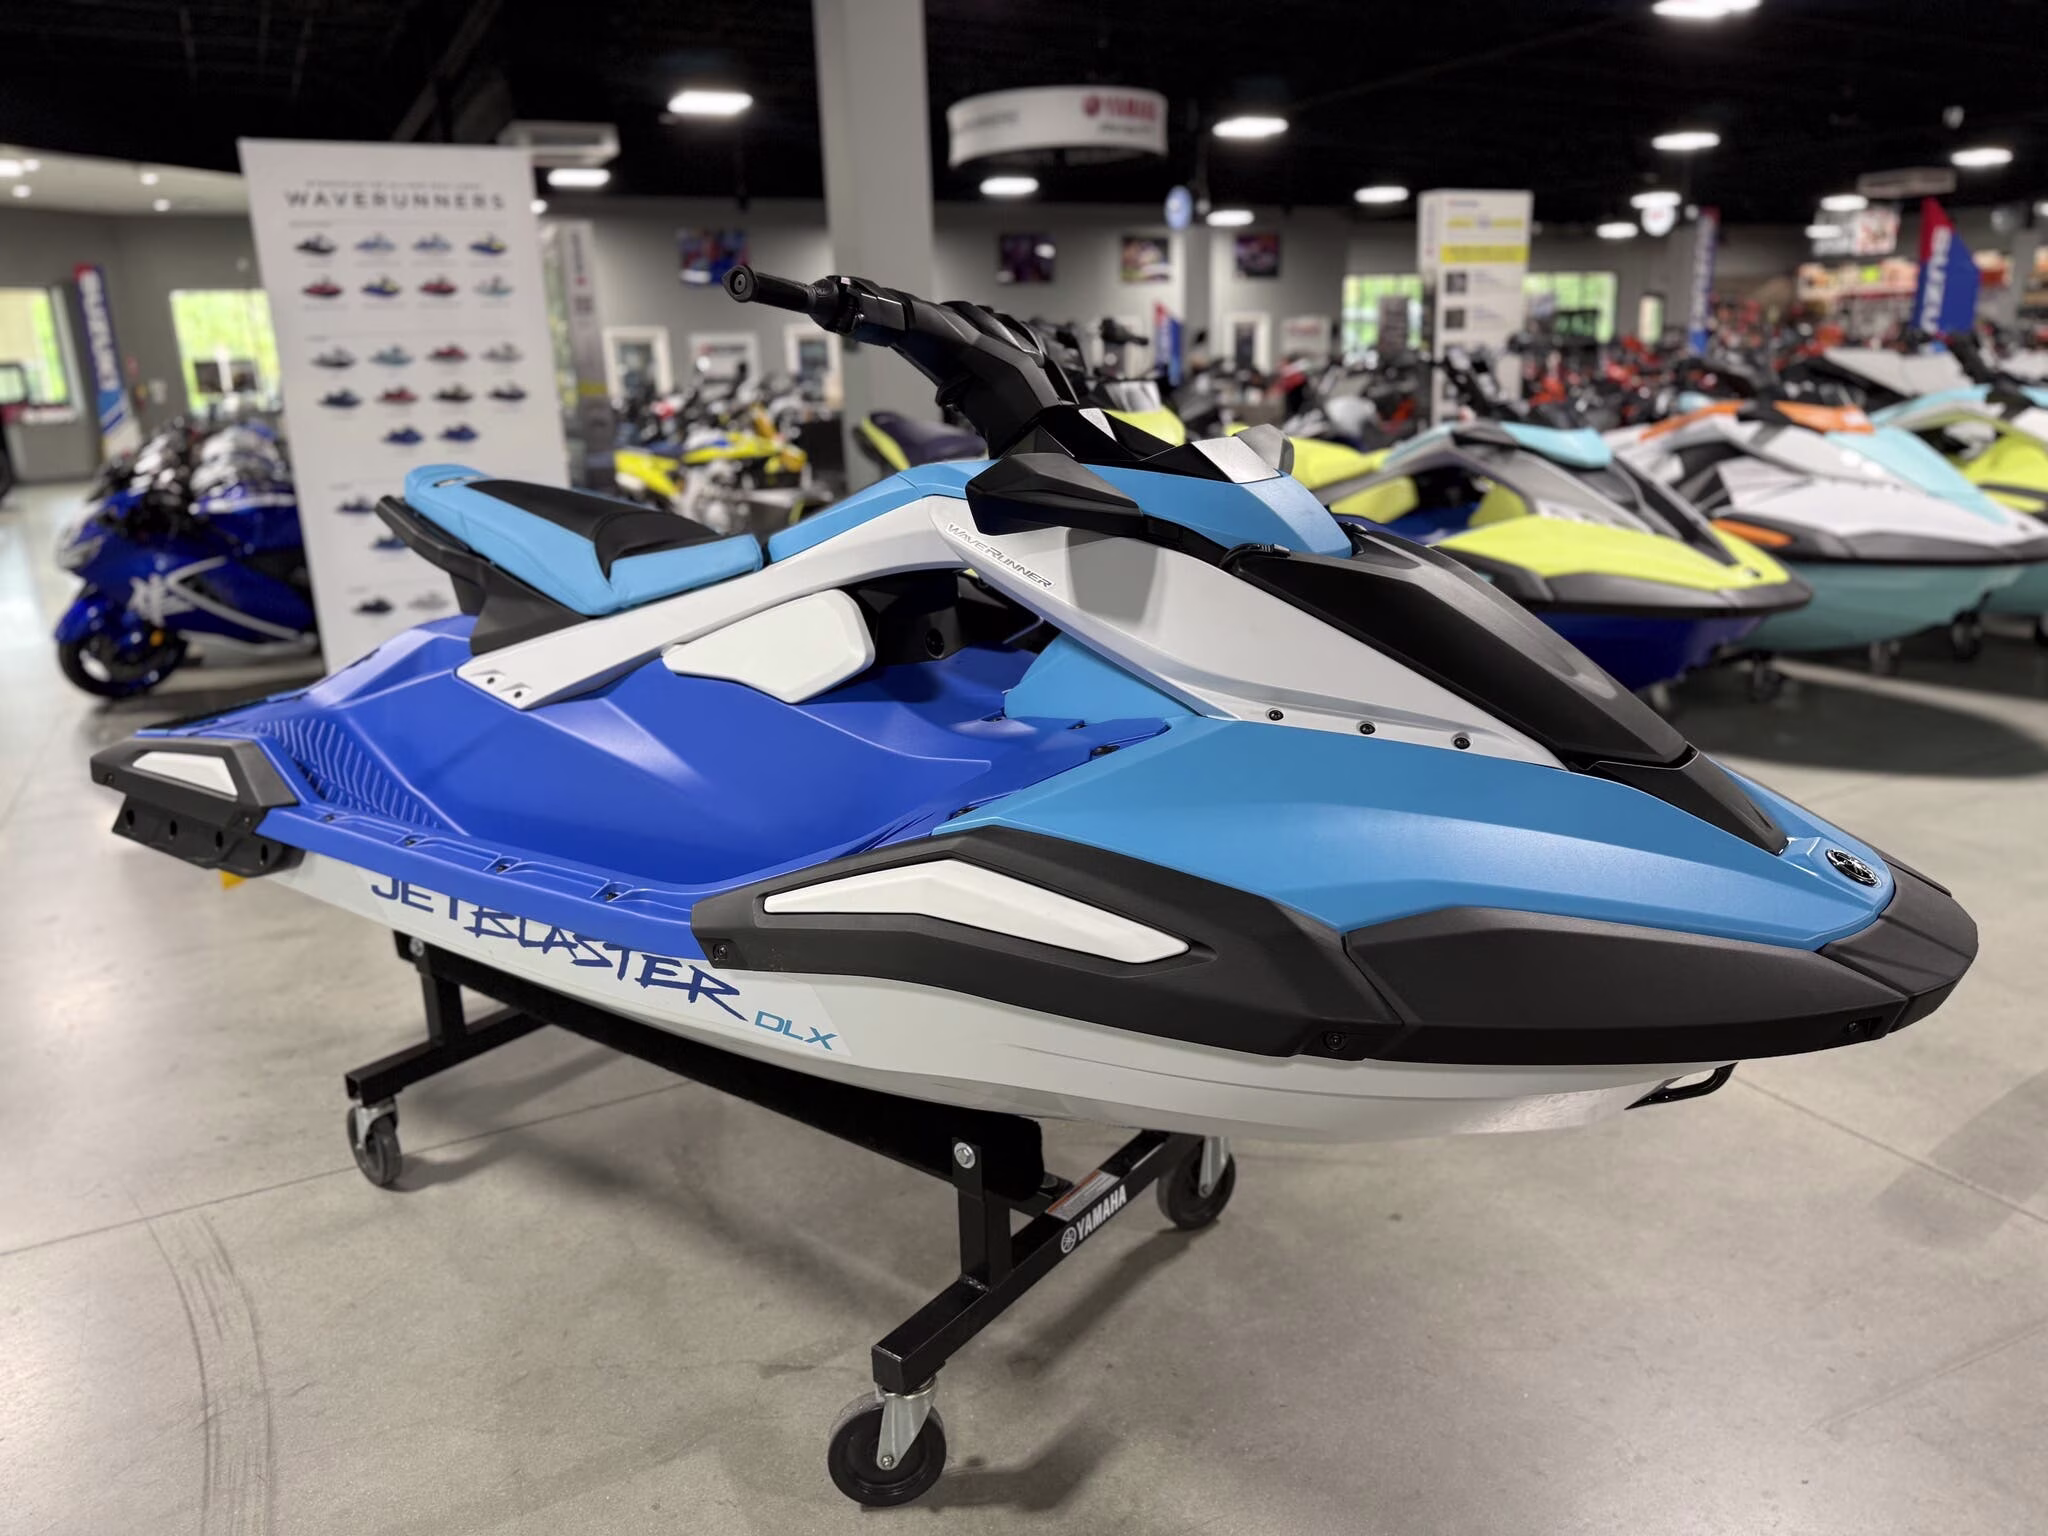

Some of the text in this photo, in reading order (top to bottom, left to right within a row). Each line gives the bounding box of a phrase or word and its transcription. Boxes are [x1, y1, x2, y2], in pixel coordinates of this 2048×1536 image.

[284, 187, 507, 211] WAVERUNNERS
[1919, 223, 1952, 335] SUZU
[947, 523, 1053, 588] WAVERUNNER
[754, 1010, 837, 1051] DLX
[1075, 1184, 1127, 1241] YAMAHA
